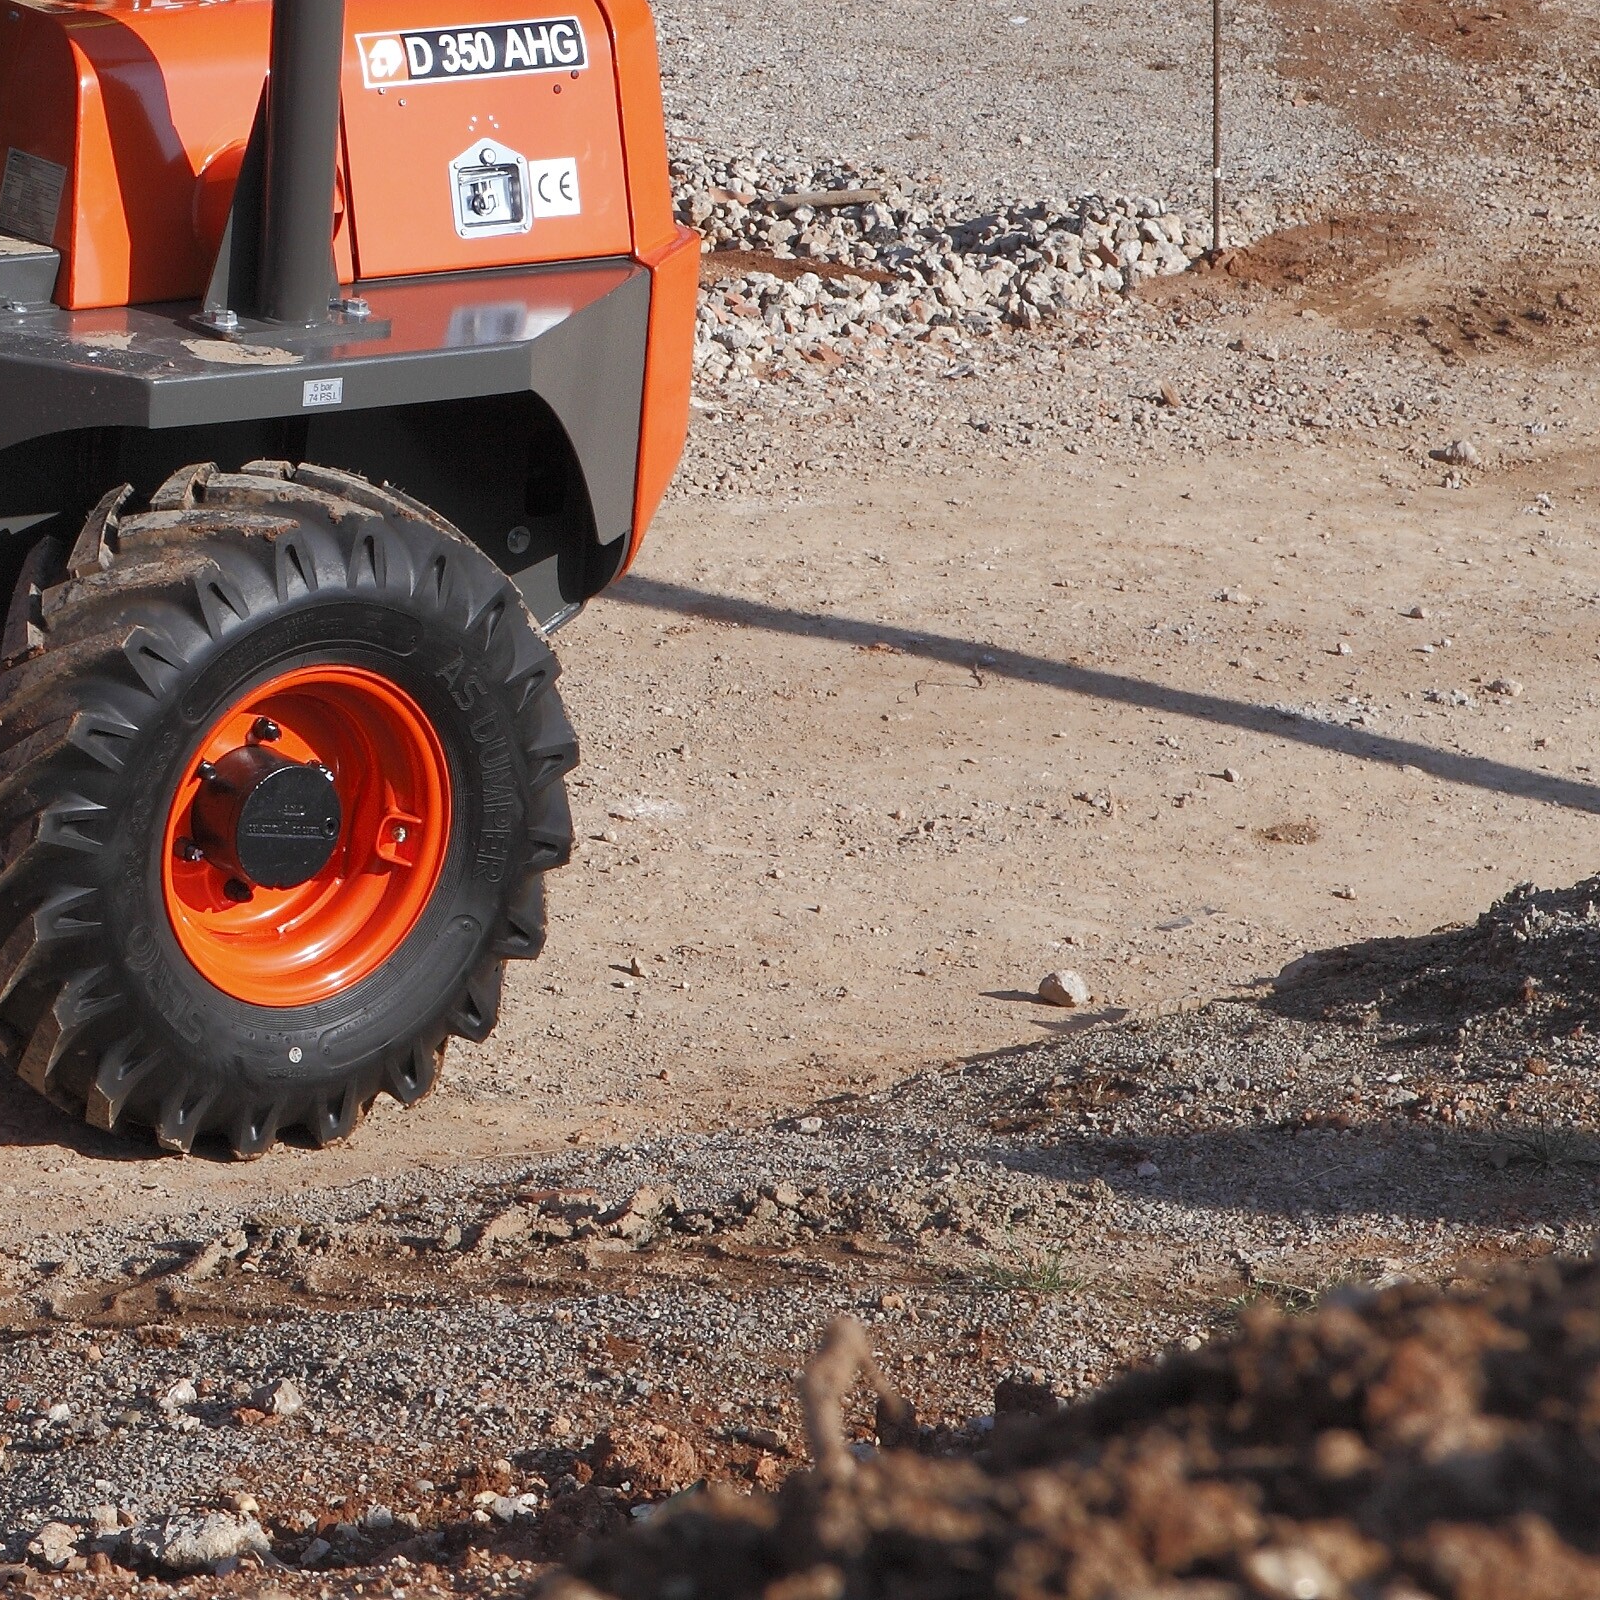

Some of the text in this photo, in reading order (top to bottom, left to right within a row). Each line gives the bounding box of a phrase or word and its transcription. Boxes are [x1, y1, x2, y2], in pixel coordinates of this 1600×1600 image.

[405, 23, 579, 76] D 350 AHG
[308, 394, 318, 403] 74
[313, 383, 334, 392] 5 bar
[469, 710, 514, 883] DUMPER
